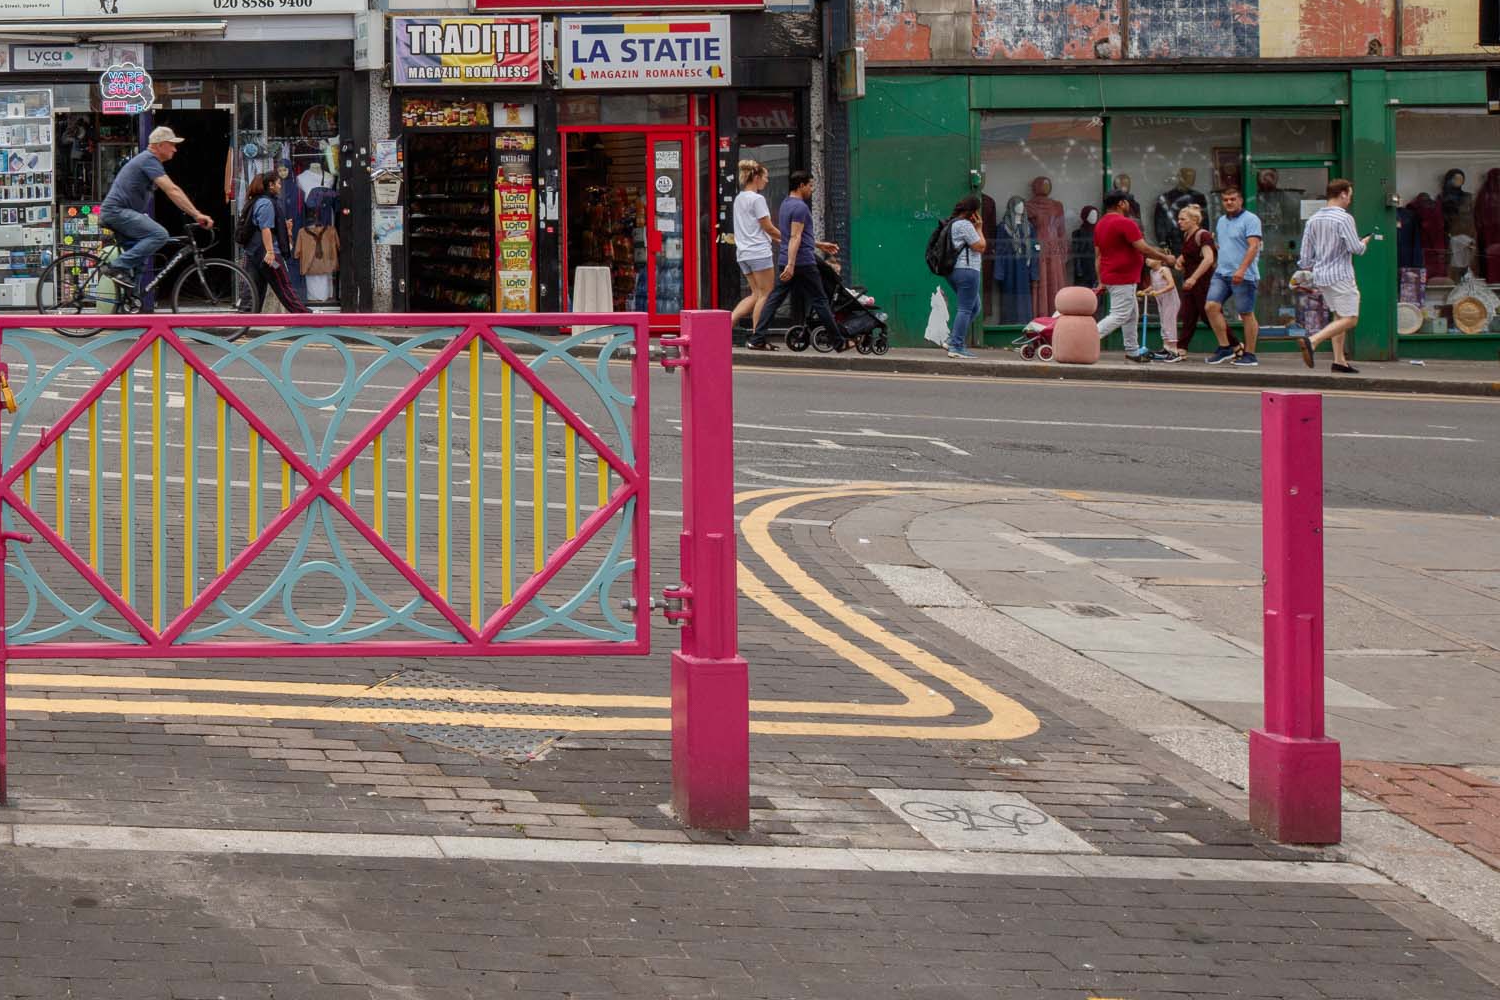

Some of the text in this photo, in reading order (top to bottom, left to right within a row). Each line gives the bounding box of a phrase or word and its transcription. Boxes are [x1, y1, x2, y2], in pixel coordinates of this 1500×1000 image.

[406, 23, 531, 63] TRADIȚII
[28, 49, 62, 63] Lyca
[572, 37, 721, 68] LA STAȚIE
[108, 71, 145, 83] VAPE
[408, 64, 529, 79] MAGAZIN ROMÂNESC
[591, 70, 639, 79] MAGAZIN
[108, 83, 144, 95] SHOP
